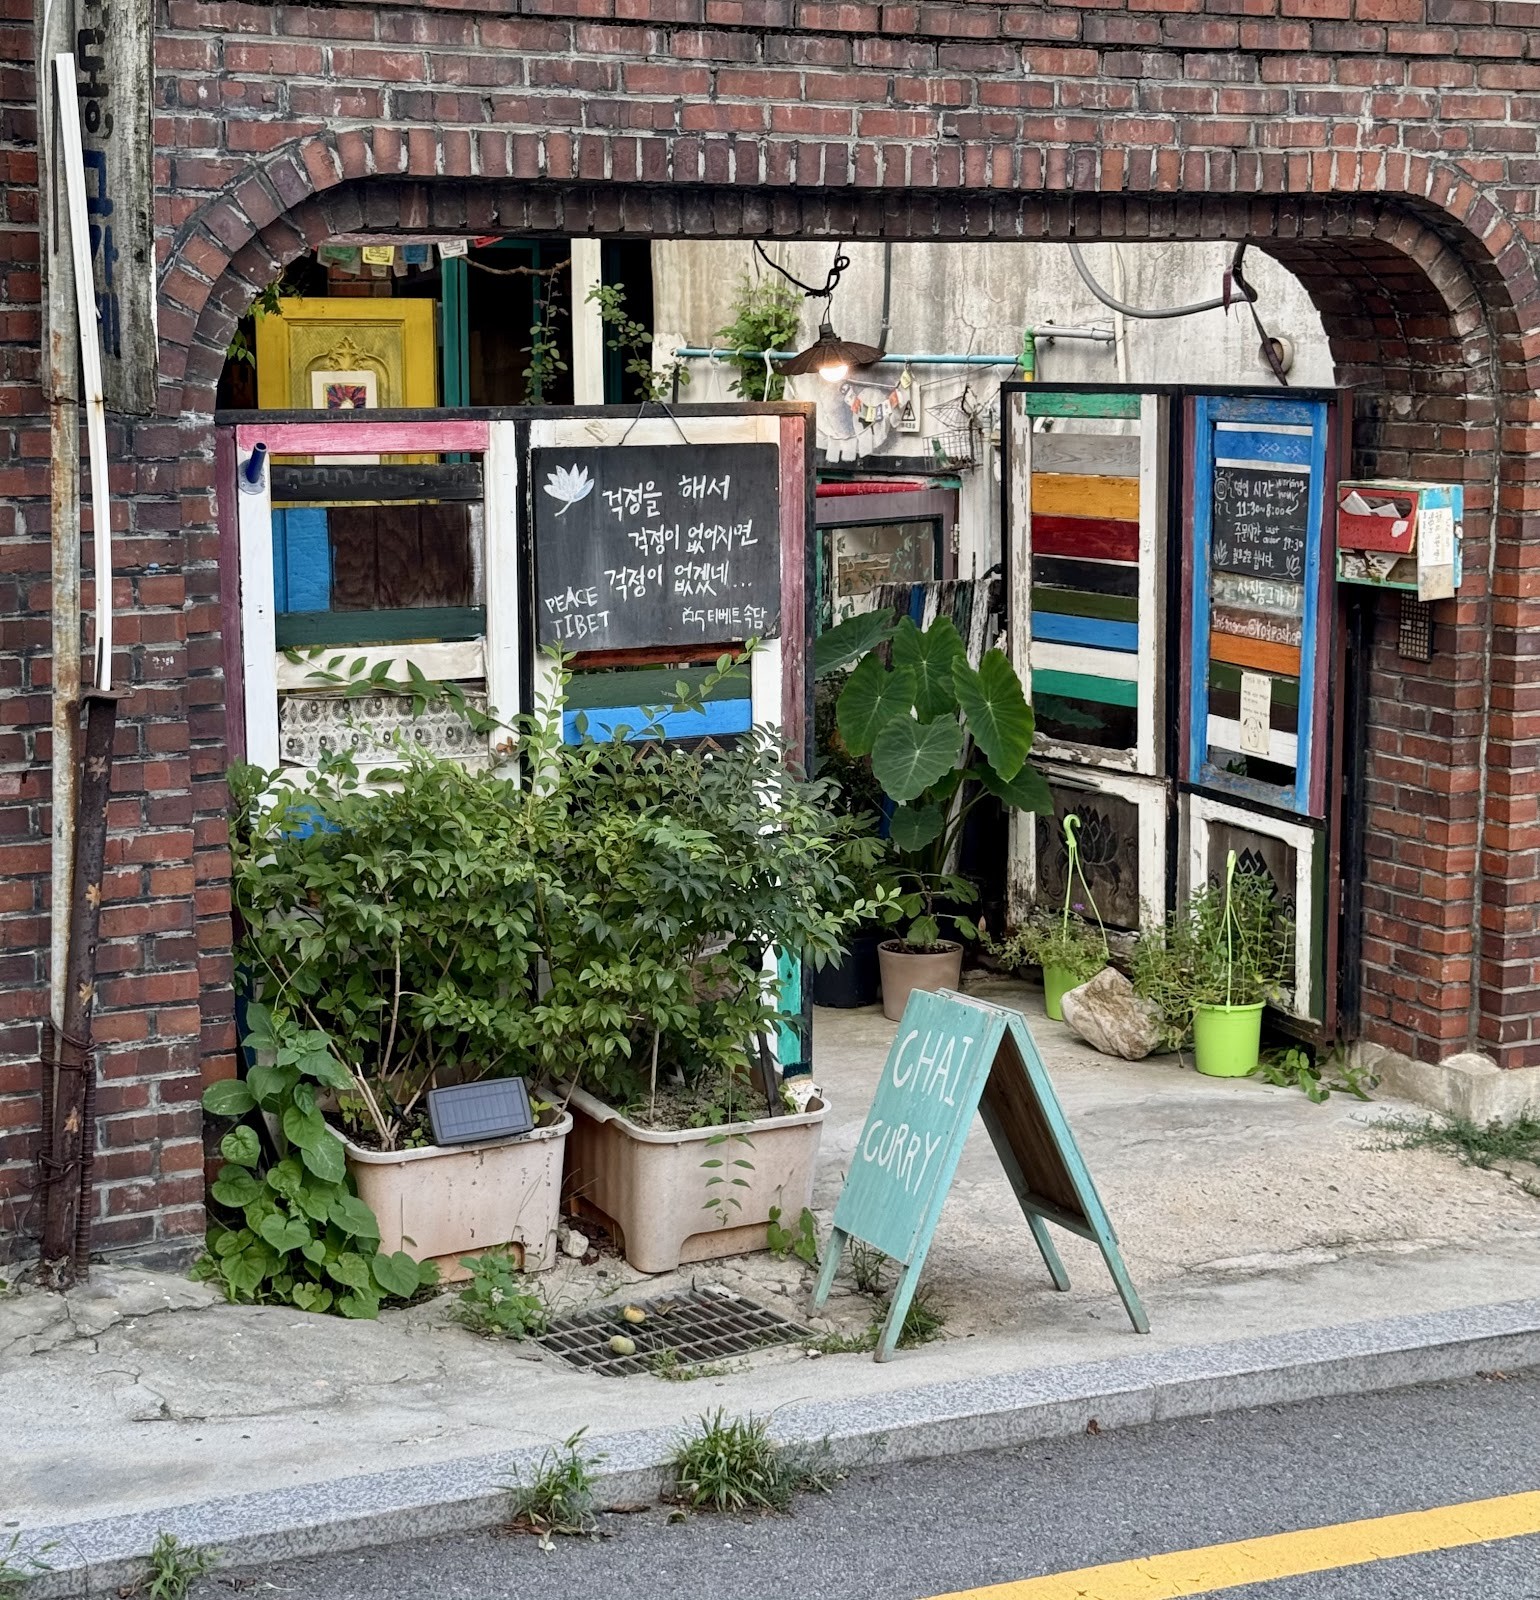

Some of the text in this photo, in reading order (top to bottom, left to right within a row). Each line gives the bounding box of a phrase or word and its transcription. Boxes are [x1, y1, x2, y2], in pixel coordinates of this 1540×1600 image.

[602, 474, 731, 522] 걱정을 해서
[1253, 479, 1274, 498] 시간
[628, 519, 759, 556] 걱정이 없어지면
[544, 586, 599, 614] PEACE
[604, 564, 663, 602] 걱정이
[550, 610, 610, 640] TIBET
[707, 604, 768, 629] 티베트 속담
[892, 1029, 974, 1107] CHAI
[863, 1119, 941, 1196] CURRY
